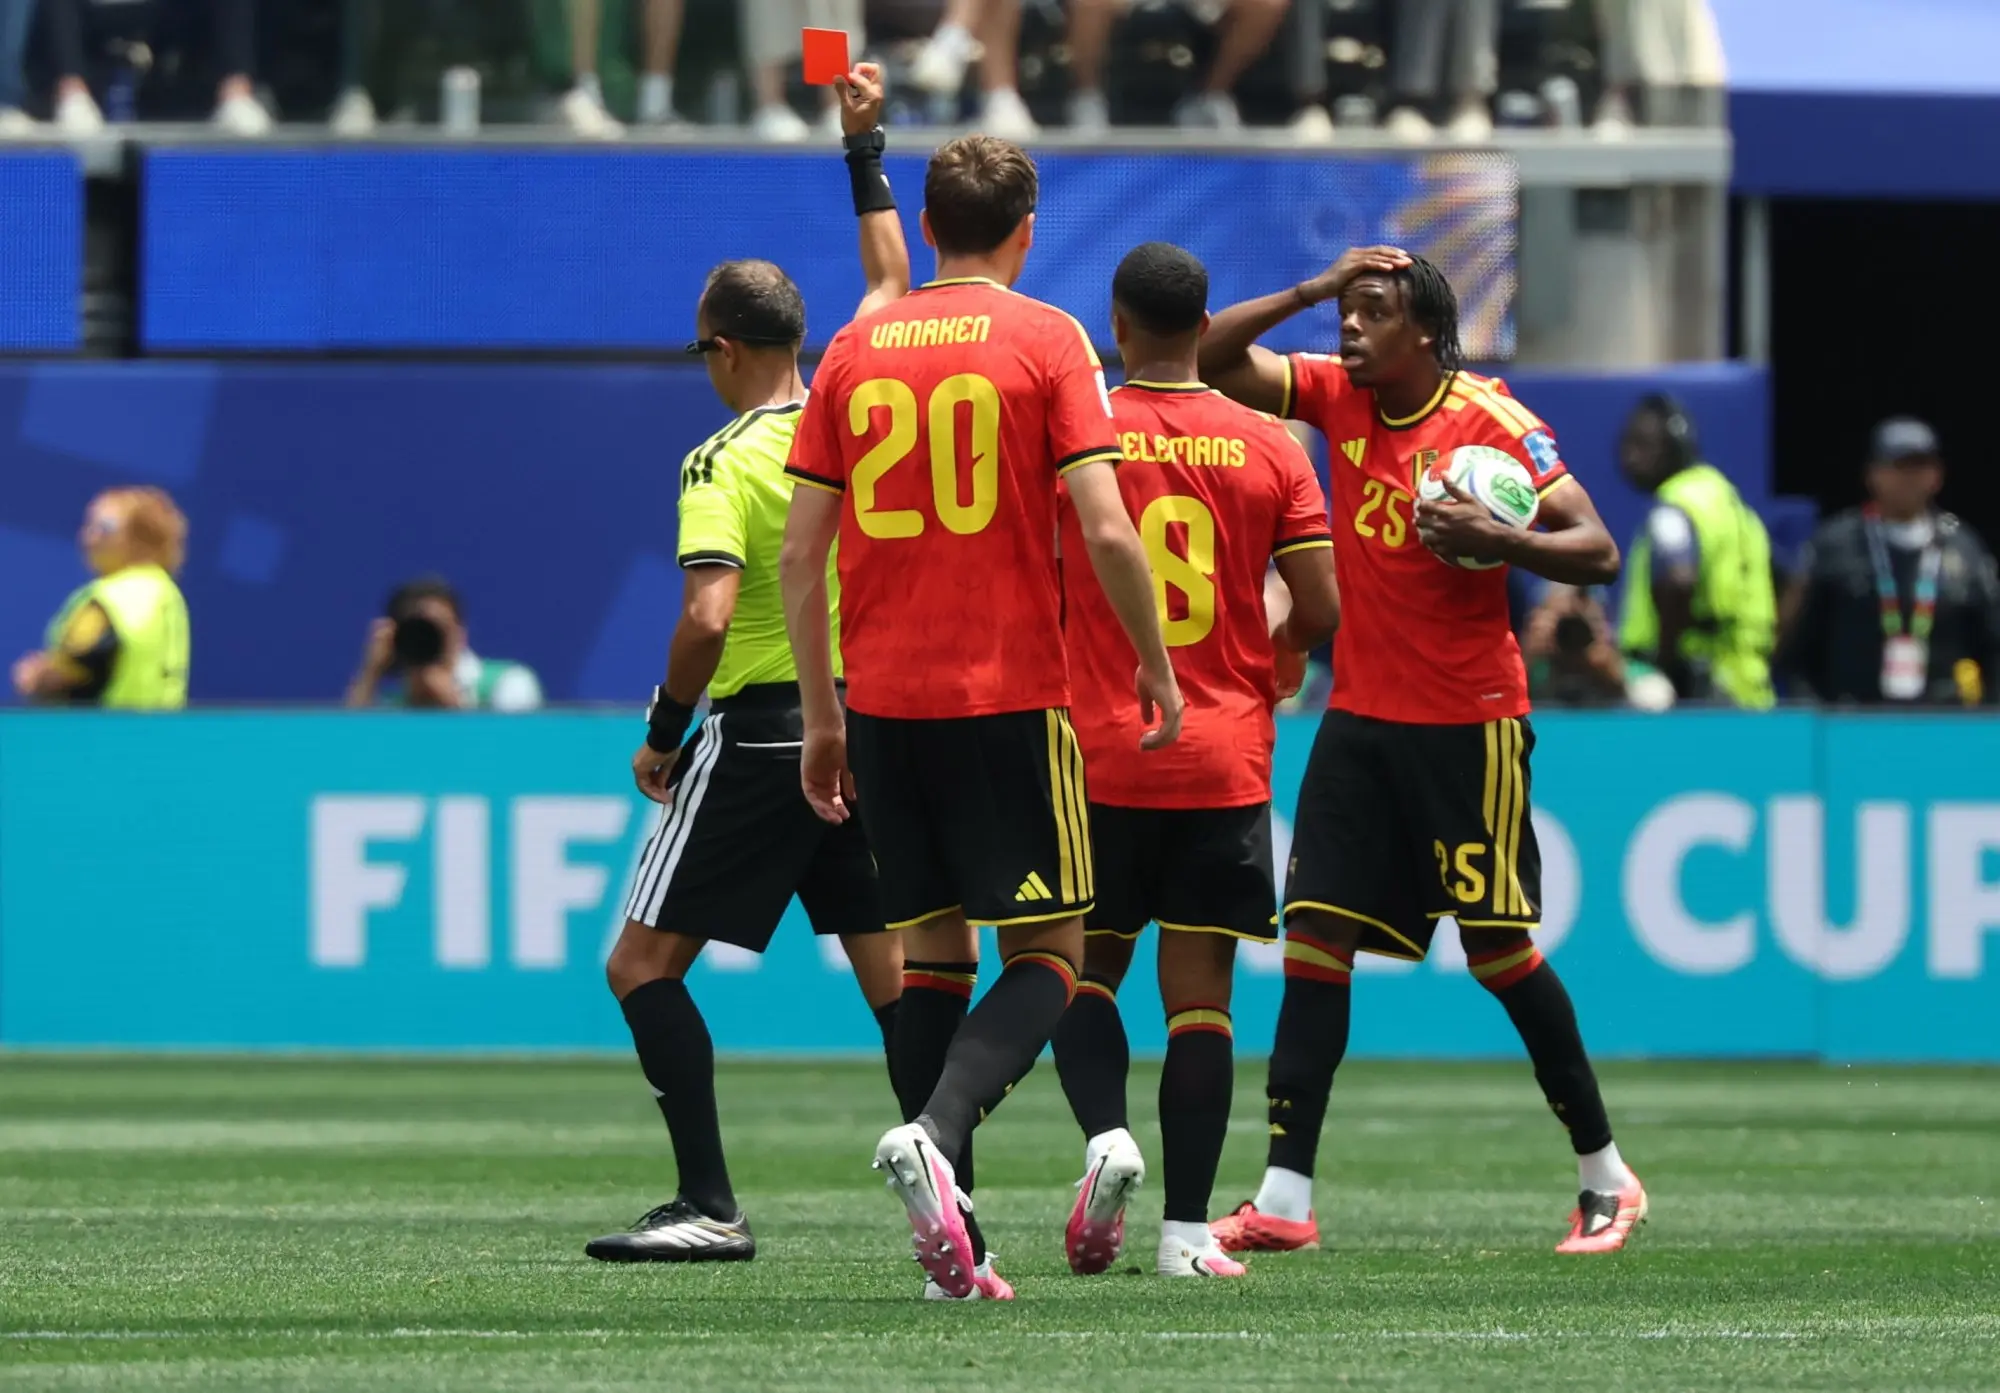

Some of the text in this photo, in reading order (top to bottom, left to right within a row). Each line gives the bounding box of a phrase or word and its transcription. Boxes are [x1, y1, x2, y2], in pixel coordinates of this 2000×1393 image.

[870, 315, 991, 349] VANAKEN
[849, 373, 1000, 539] 20
[1116, 431, 1246, 468] ELEMANS
[1354, 478, 1412, 548] 25
[1139, 495, 1215, 647] 8
